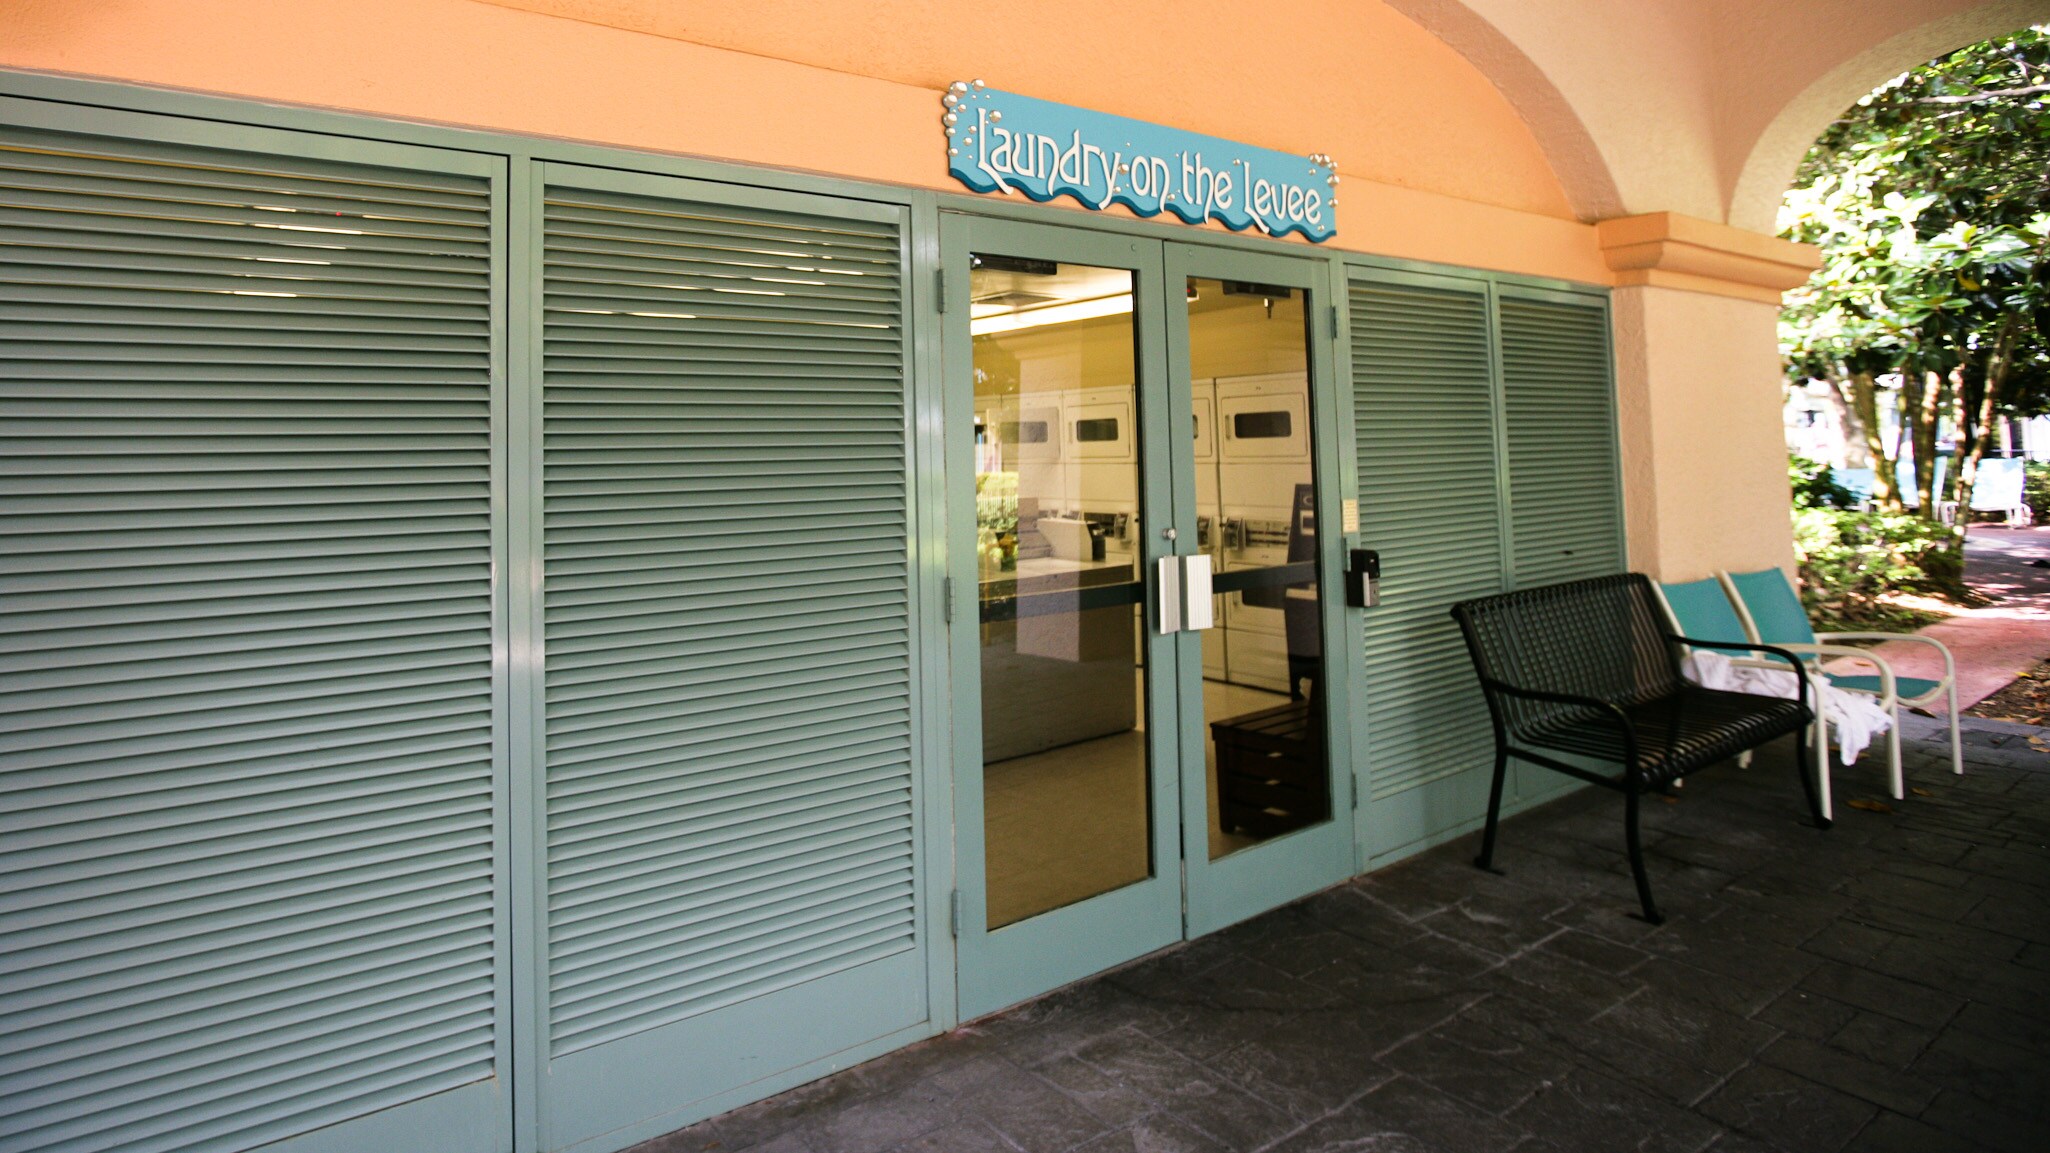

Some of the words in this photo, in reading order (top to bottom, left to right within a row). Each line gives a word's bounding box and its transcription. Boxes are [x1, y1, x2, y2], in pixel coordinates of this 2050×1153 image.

[976, 107, 1121, 210] Laundry
[1130, 153, 1170, 213] on
[1182, 150, 1232, 225] the
[1243, 162, 1321, 234] Levee
